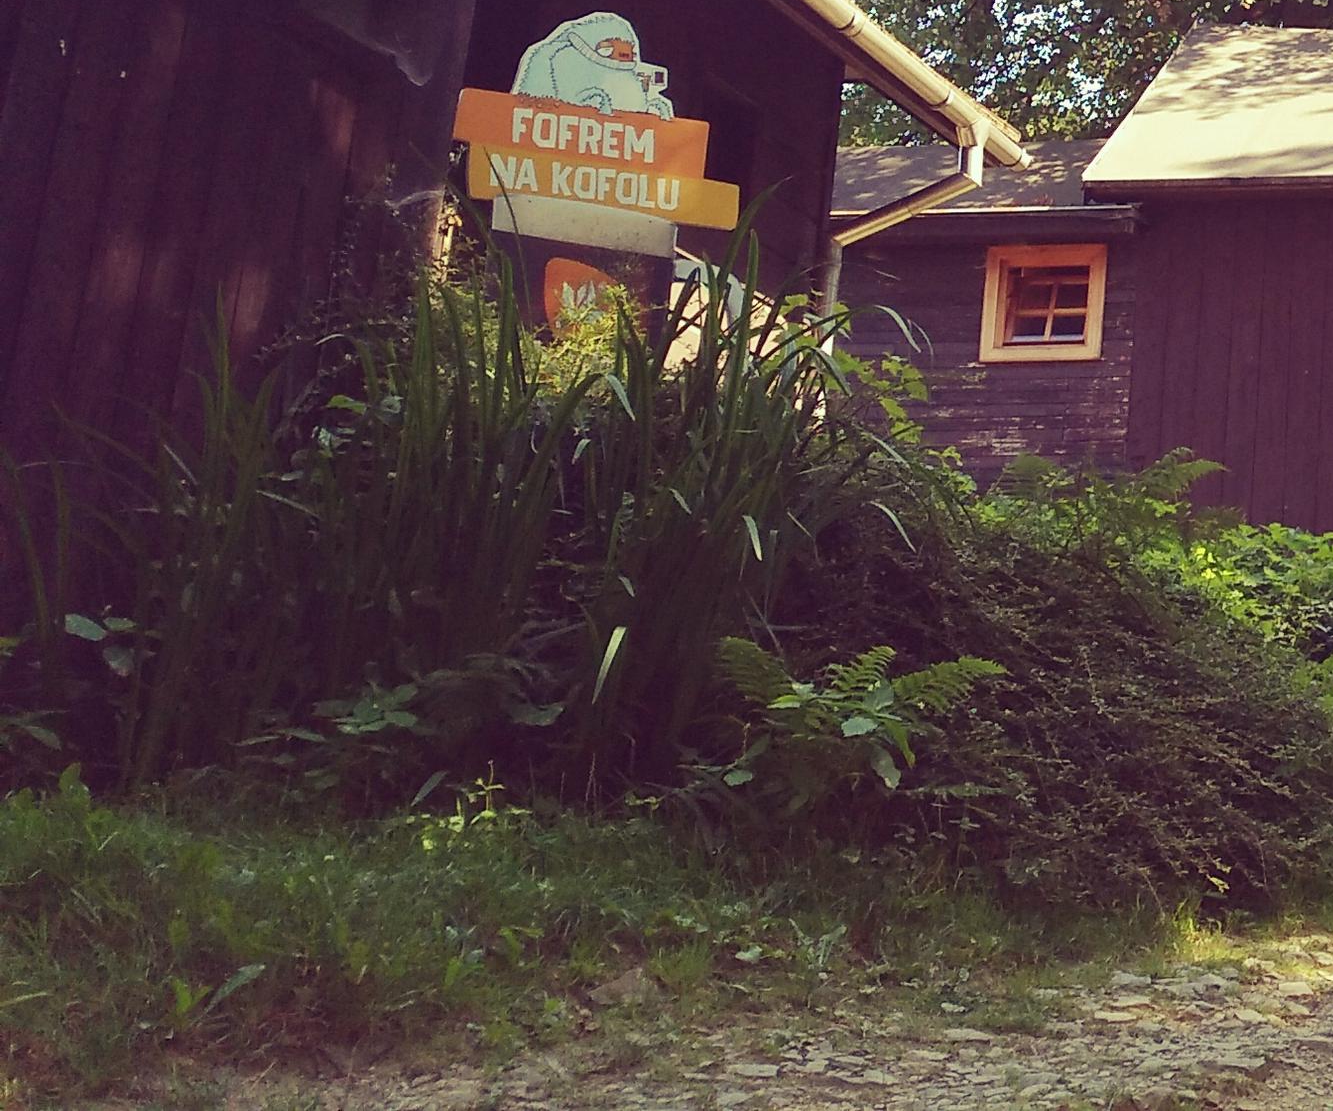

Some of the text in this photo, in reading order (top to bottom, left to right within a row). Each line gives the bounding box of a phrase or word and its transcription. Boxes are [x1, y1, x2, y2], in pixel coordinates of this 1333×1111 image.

[511, 107, 655, 163] FOFREM
[488, 152, 681, 211] NA KOFOLU
